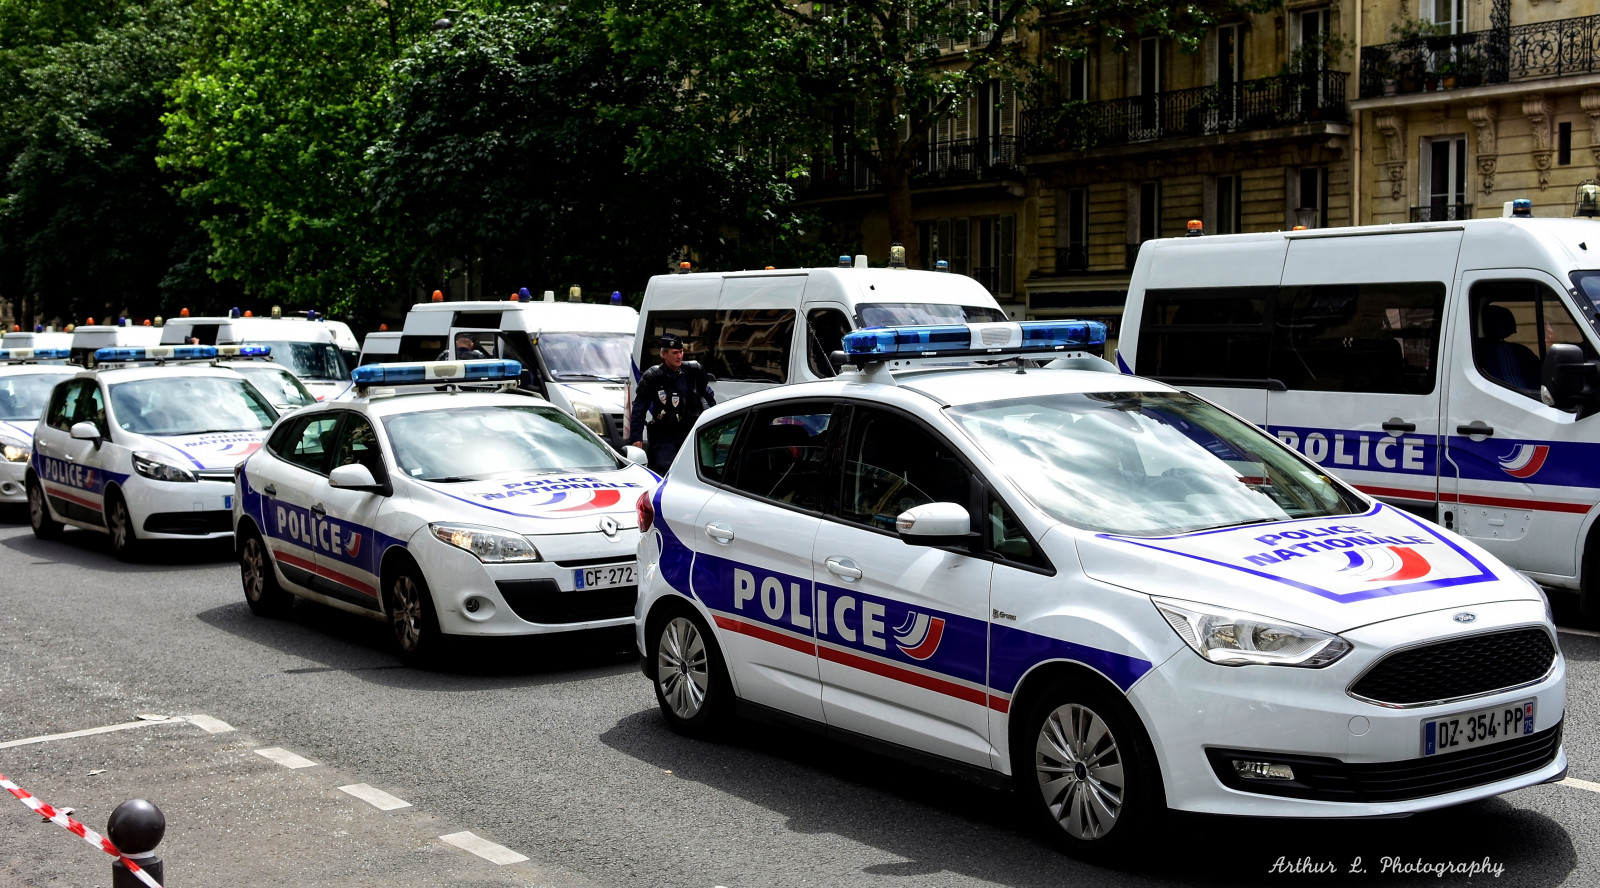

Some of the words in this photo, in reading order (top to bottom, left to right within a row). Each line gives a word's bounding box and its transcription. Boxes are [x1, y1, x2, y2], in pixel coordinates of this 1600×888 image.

[1277, 430, 1425, 471] POLICE
[45, 458, 83, 488] POLICE
[502, 476, 603, 490] POLICE
[482, 482, 643, 501] NATIONALE
[276, 505, 342, 556] POLICE
[1254, 525, 1374, 546] POLICE
[1243, 535, 1435, 567] NATIONALE
[733, 567, 887, 651] POLICE
[1524, 720, 1533, 734] 75
